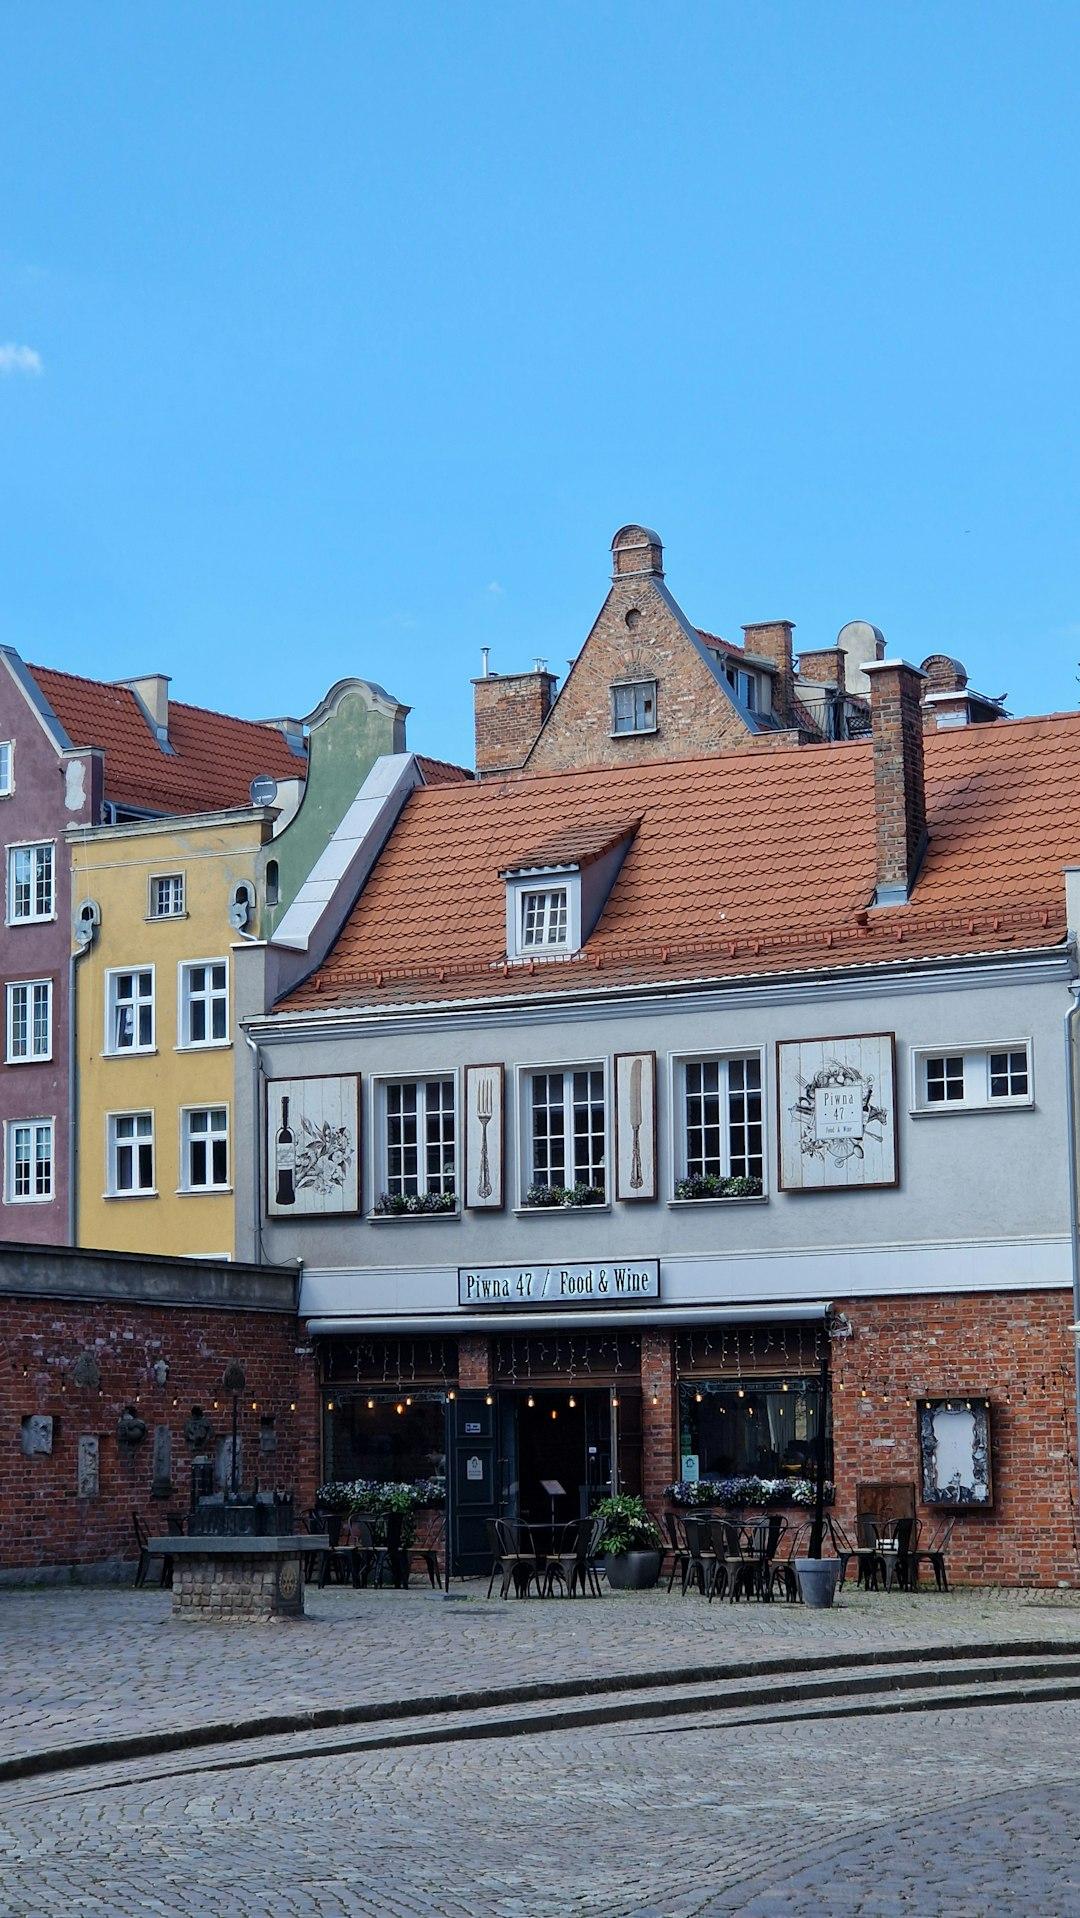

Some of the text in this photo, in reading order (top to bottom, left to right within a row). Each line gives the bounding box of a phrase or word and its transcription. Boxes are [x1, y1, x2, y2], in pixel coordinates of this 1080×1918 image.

[824, 1093, 854, 1106] Piwna
[833, 1107, 844, 1120] 47
[466, 1268, 649, 1298] Piwna 47 / Food & Wine
